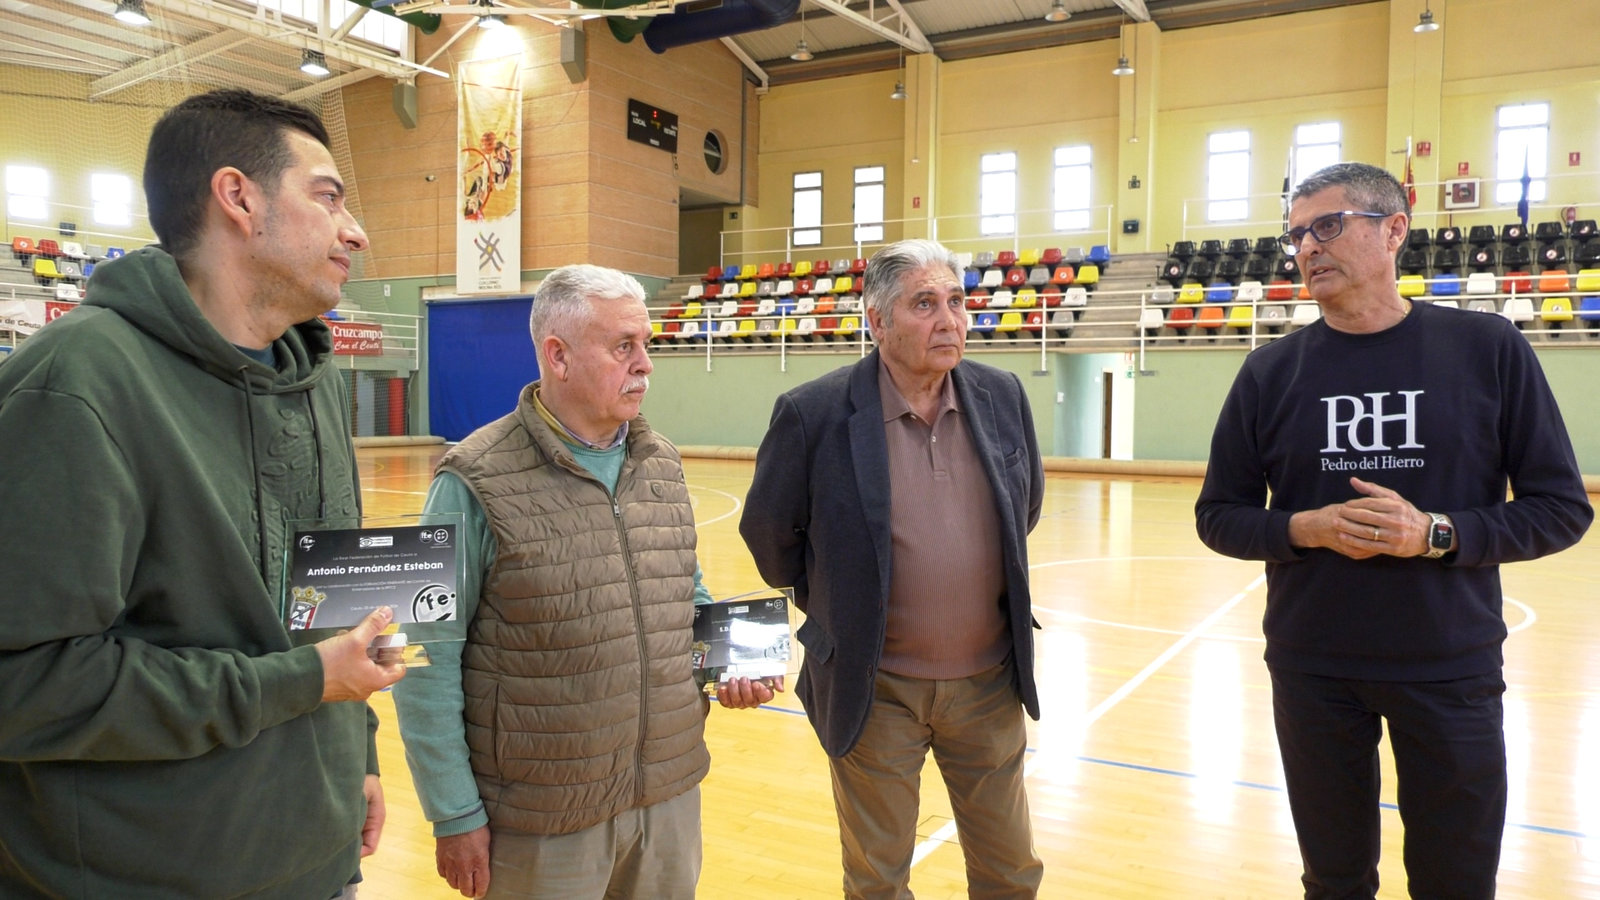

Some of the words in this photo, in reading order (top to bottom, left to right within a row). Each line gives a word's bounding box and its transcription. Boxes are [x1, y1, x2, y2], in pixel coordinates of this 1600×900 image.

[333, 326, 383, 341] Cruzcampo
[1320, 390, 1425, 453] PdH
[1320, 457, 1357, 471] Pedro
[1359, 456, 1378, 469] del
[1381, 455, 1425, 469] Hierro
[307, 565, 346, 577] Antonio
[348, 563, 402, 574] Fernández
[404, 561, 444, 571] Esteban
